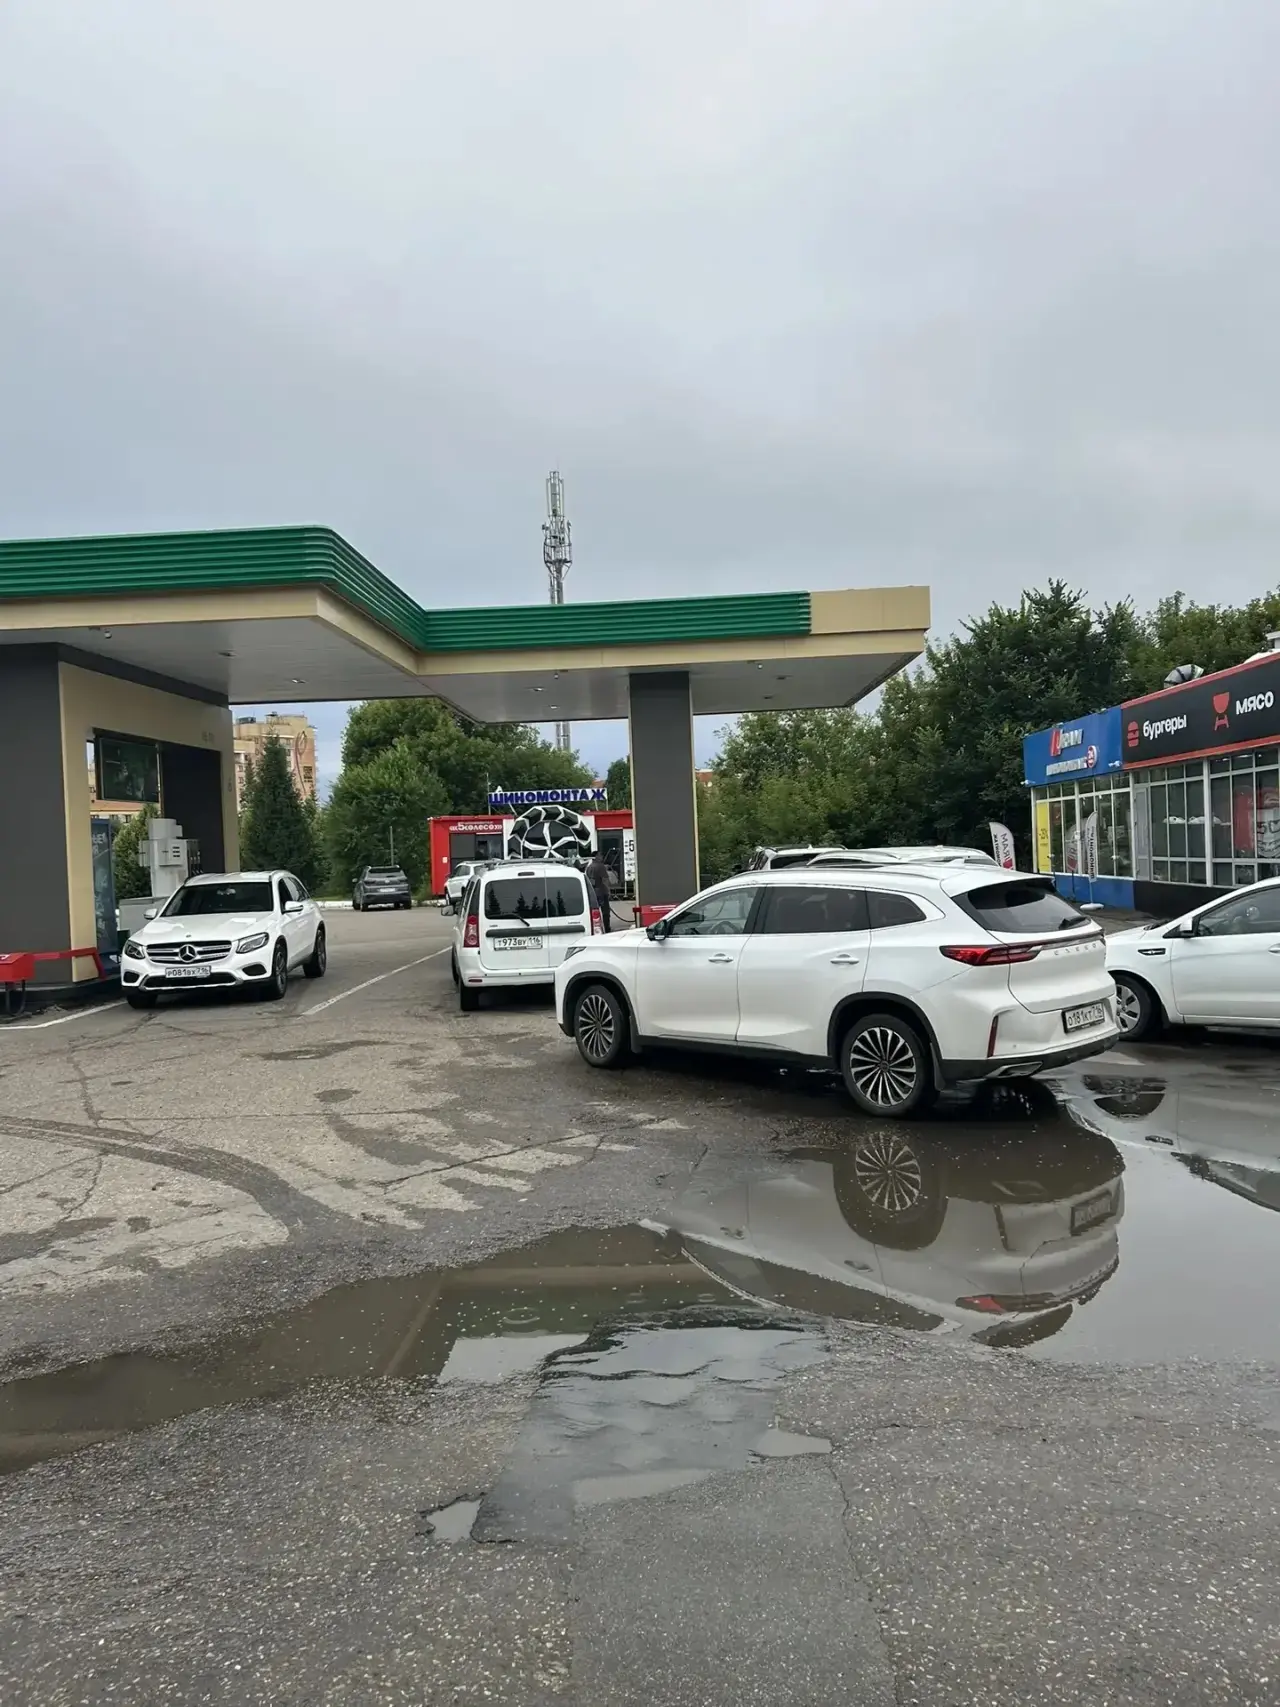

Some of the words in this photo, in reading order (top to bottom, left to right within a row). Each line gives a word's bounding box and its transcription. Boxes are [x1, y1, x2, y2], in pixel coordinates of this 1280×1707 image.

[1235, 690, 1274, 715] мясо
[1142, 714, 1187, 740] бургеры
[488, 788, 605, 804] ШИНОМОНТАЖ
